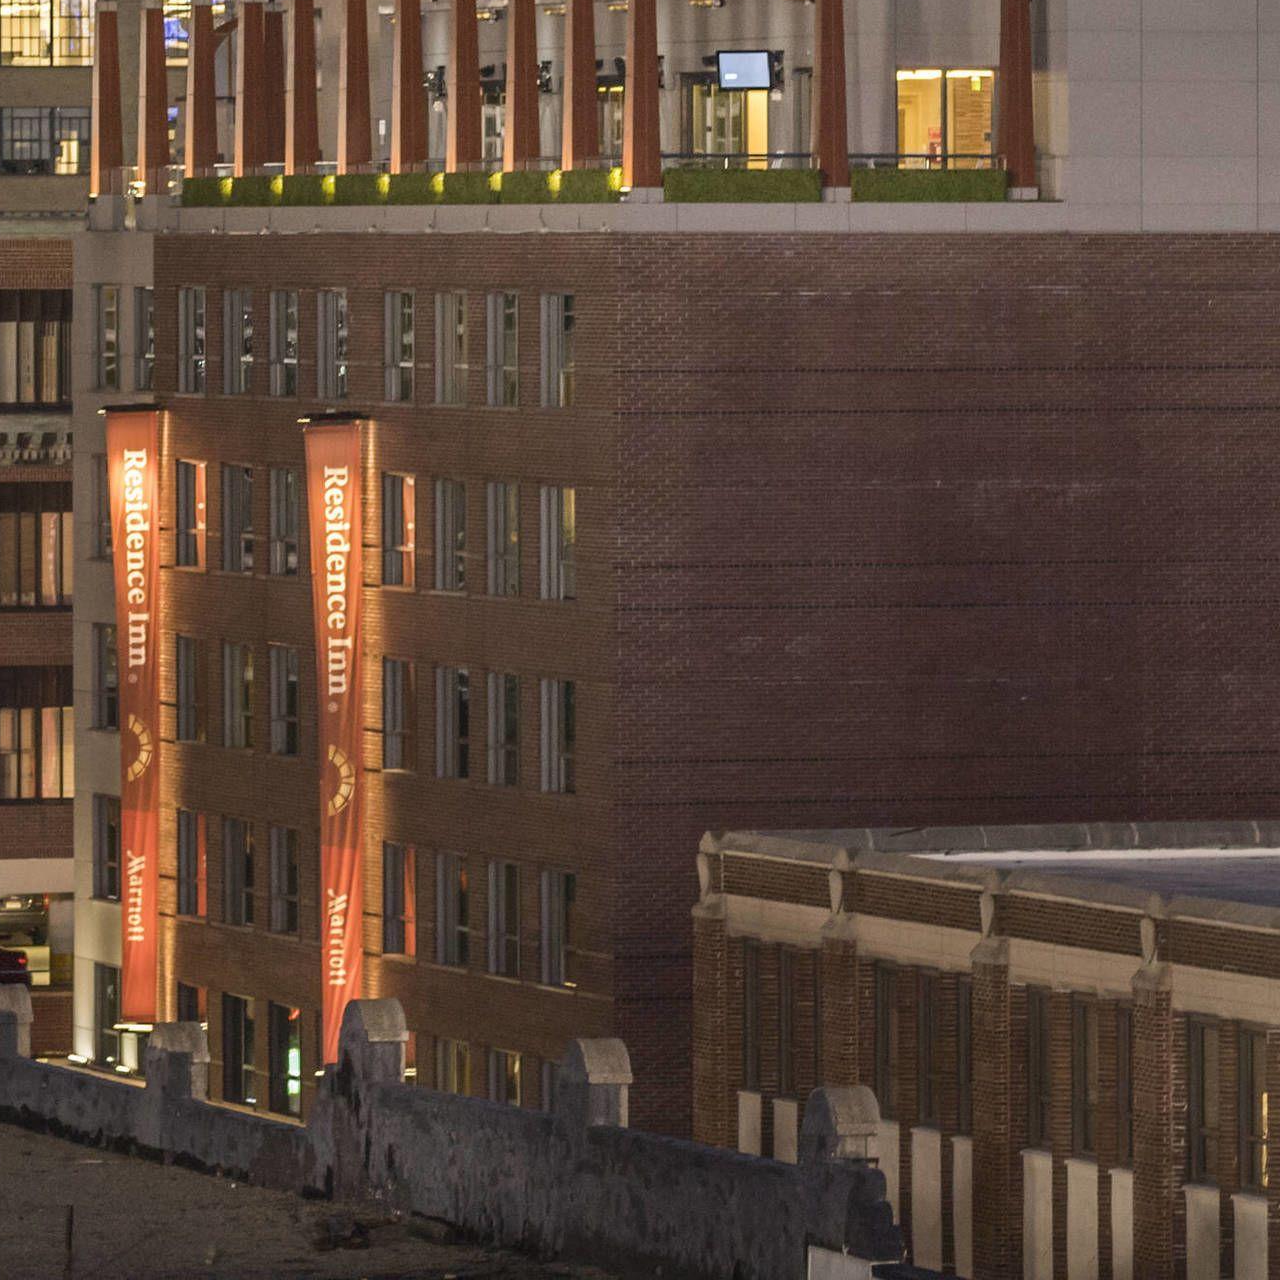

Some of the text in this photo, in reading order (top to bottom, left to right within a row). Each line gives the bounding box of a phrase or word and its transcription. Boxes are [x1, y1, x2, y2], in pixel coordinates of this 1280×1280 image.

[123, 448, 150, 668] Residence Inn
[324, 466, 352, 696] Residence Inn
[126, 849, 145, 941] Marriott
[327, 888, 347, 986] Marriott
